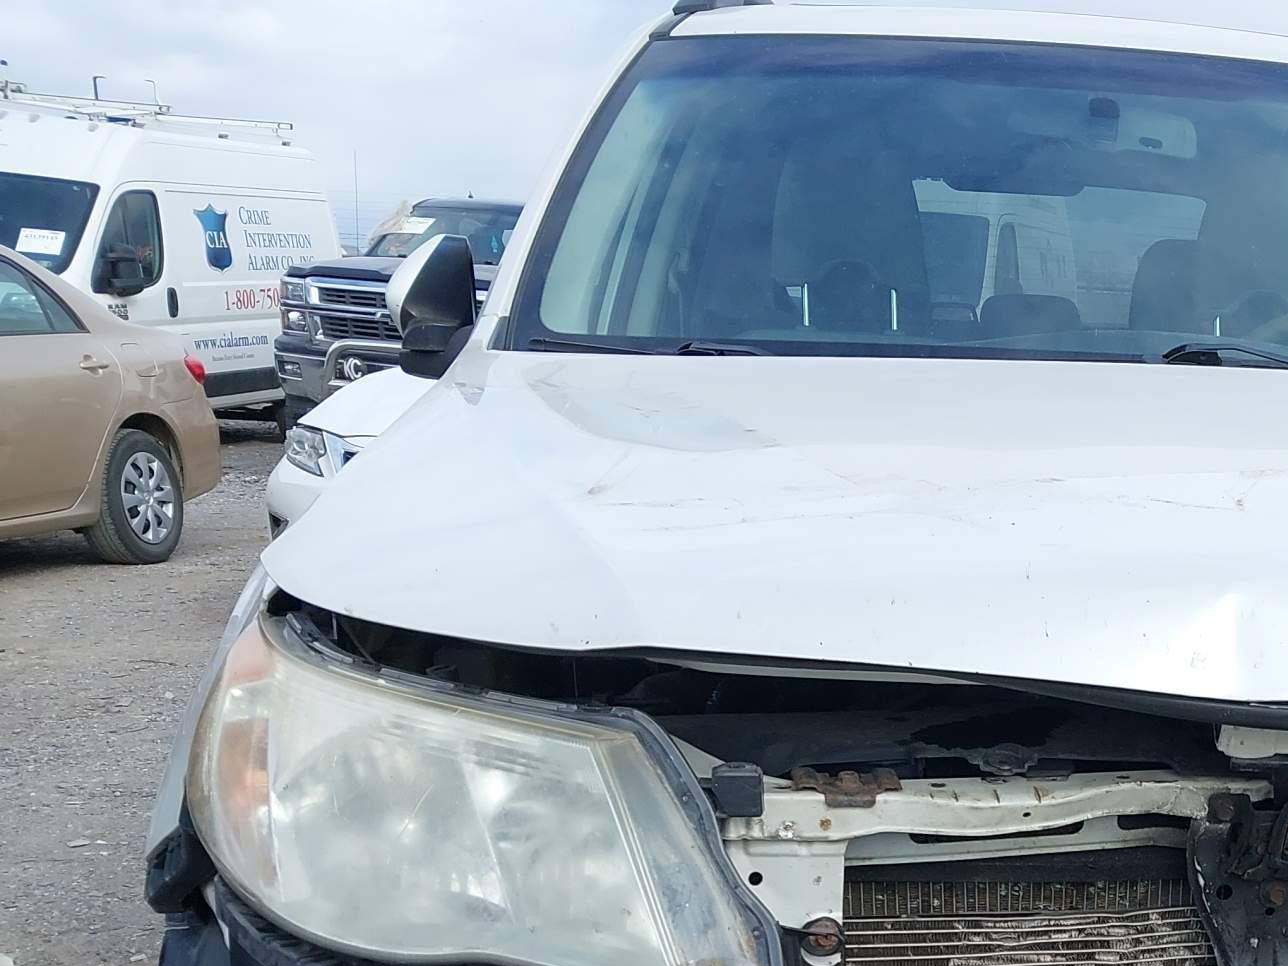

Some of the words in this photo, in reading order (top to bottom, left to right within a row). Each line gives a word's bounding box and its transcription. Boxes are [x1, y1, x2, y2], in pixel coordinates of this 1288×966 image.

[238, 206, 272, 226] CRIME
[206, 230, 228, 248] CIA
[243, 230, 312, 249] INTERVENTION
[248, 252, 280, 271] ALARM
[194, 331, 269, 352] www.cialarm.com
[343, 357, 363, 380] KC
